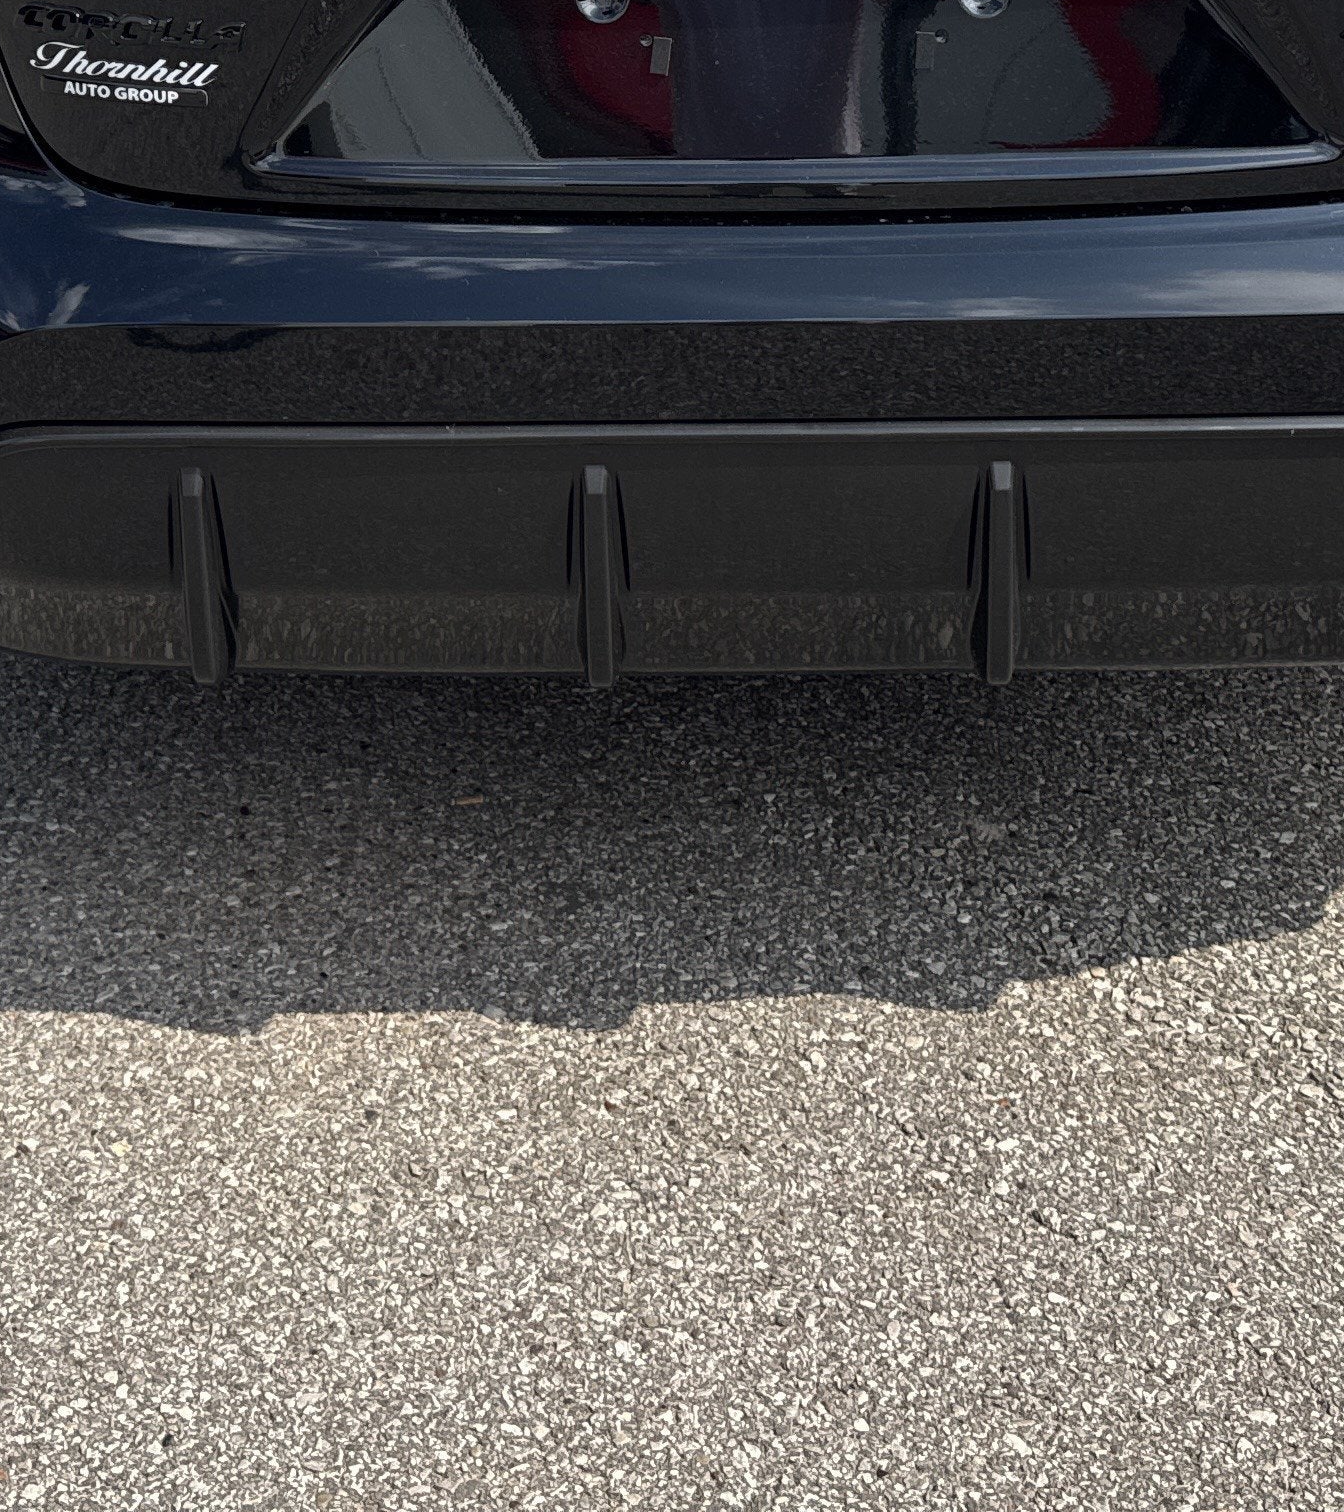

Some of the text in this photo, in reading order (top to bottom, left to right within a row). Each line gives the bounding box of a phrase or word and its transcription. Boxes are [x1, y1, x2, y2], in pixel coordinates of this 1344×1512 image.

[29, 41, 219, 87] Thornhill
[63, 80, 179, 104] AUTO GROUP
